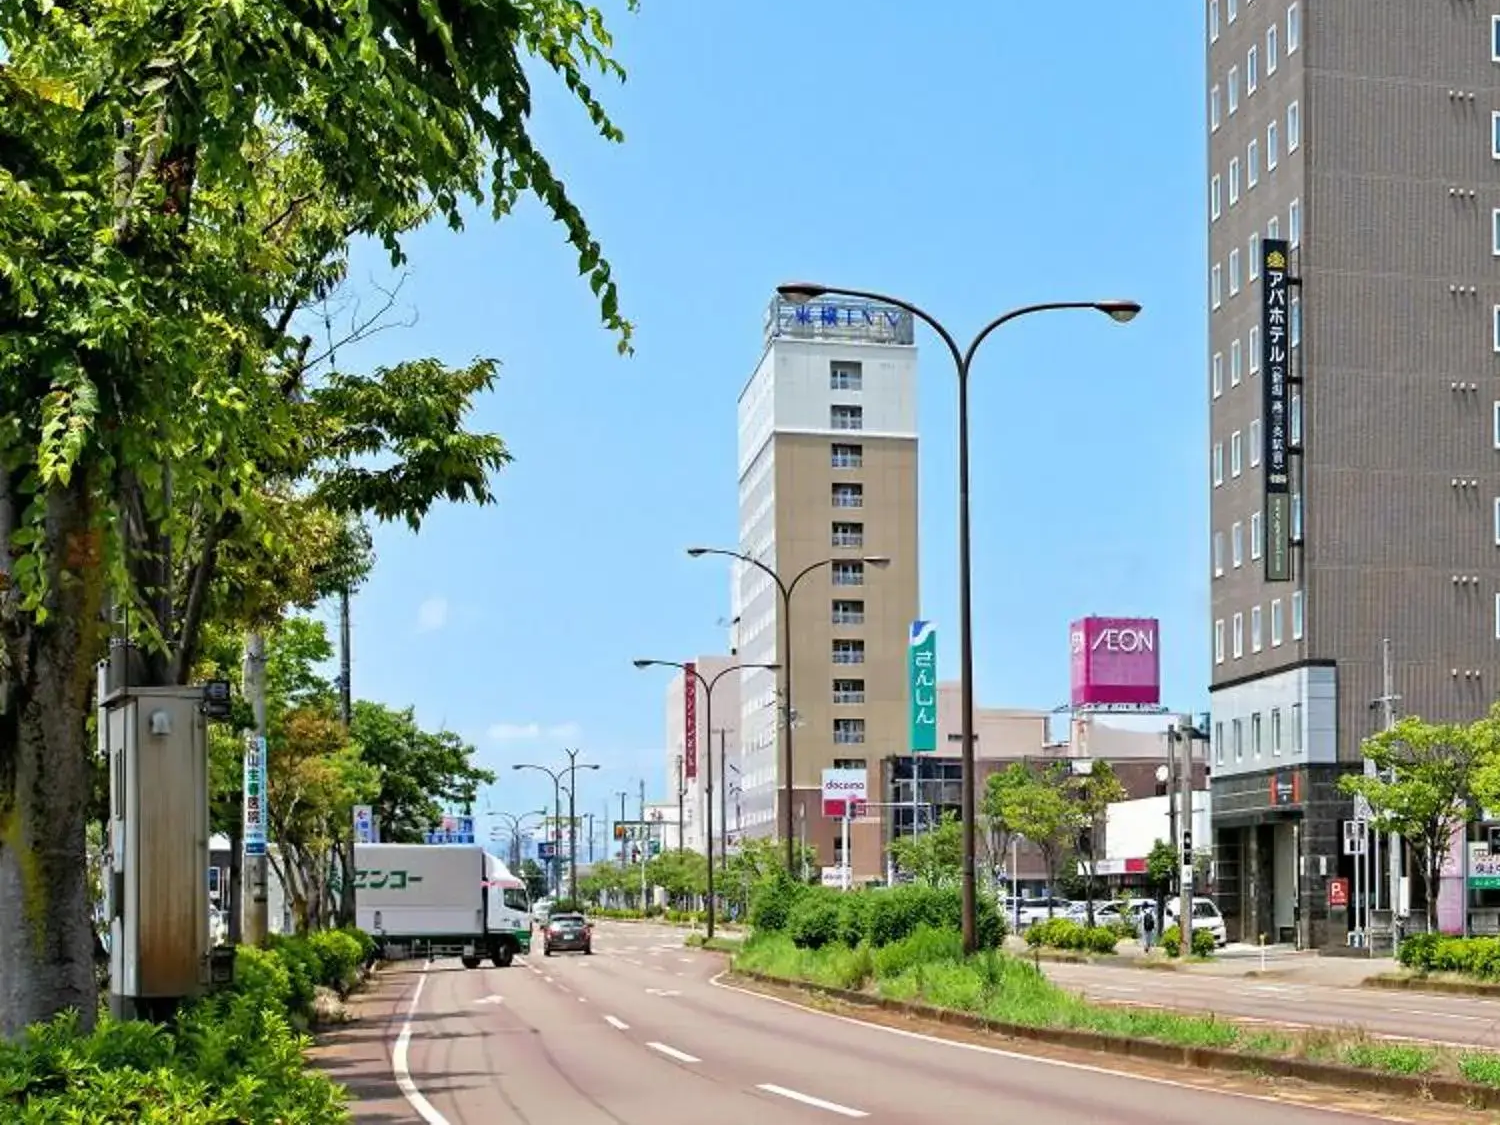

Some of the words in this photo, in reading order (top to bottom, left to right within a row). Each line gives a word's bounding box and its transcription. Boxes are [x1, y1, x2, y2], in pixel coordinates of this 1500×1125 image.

[1267, 271, 1285, 362] アパホテル
[914, 650, 933, 724] さんしん
[825, 779, 865, 790] docomo
